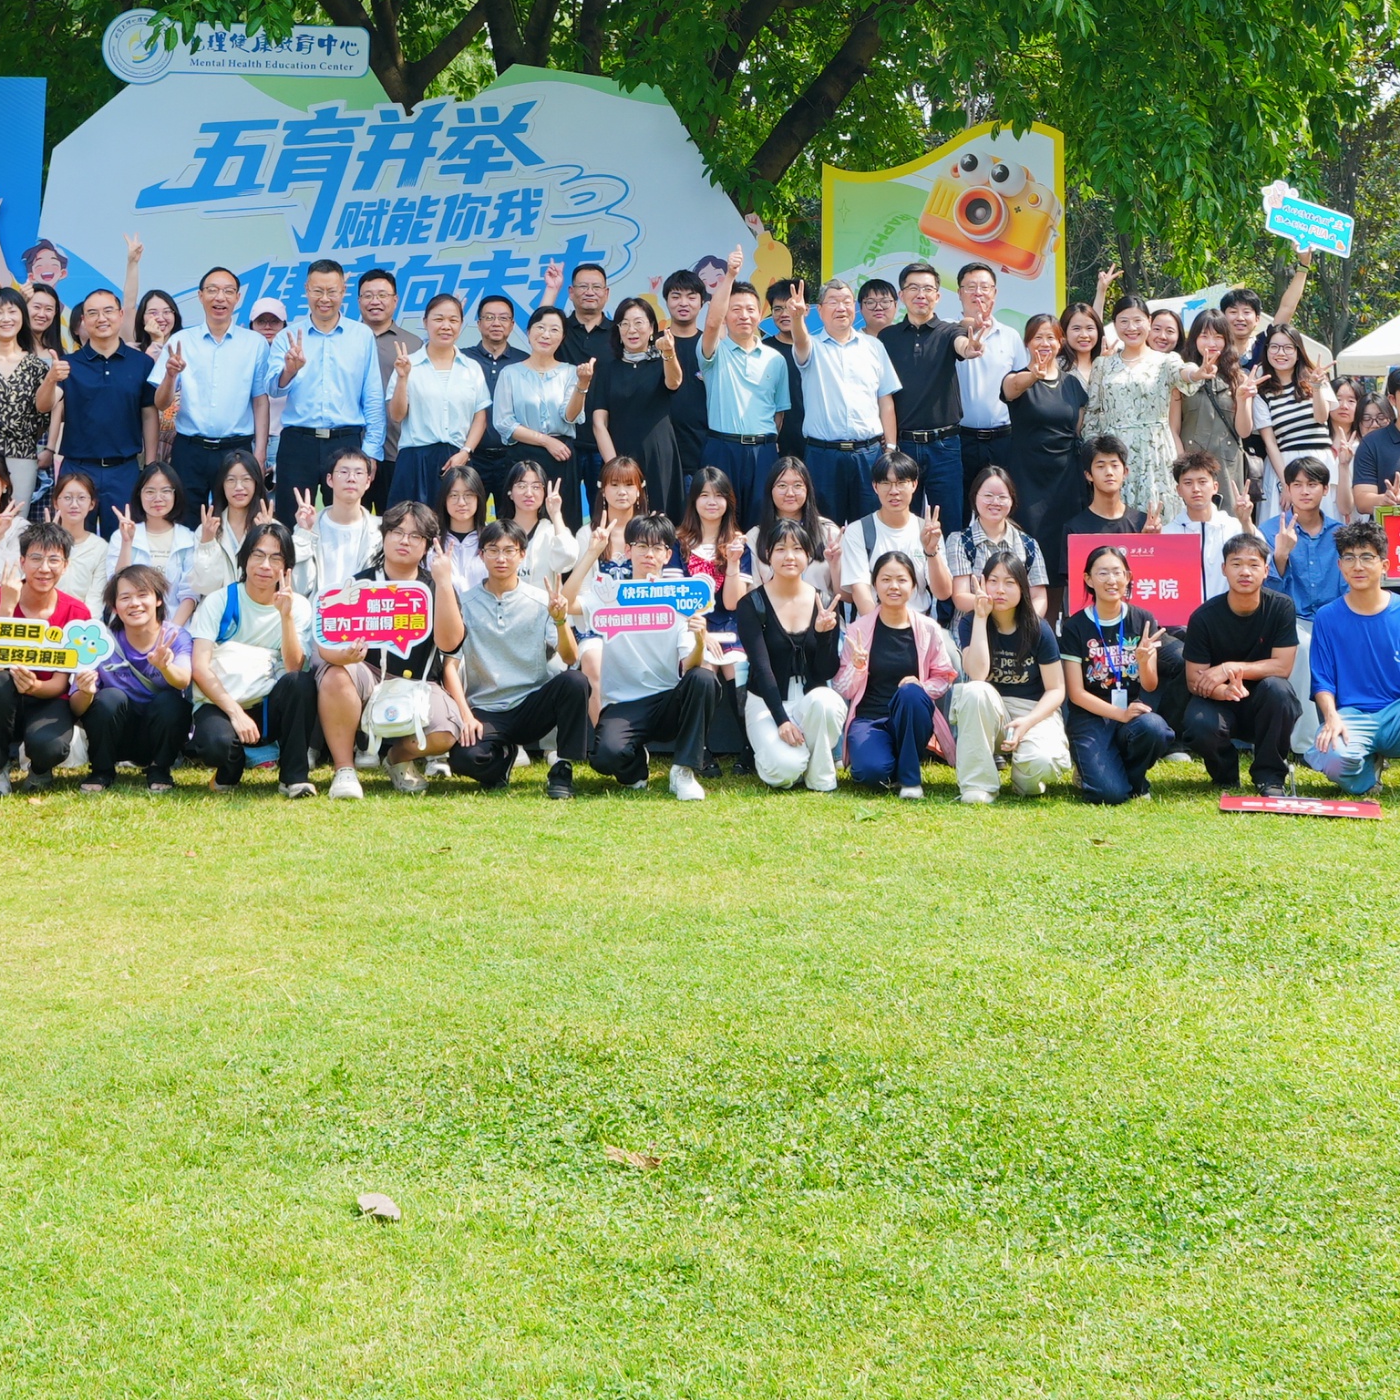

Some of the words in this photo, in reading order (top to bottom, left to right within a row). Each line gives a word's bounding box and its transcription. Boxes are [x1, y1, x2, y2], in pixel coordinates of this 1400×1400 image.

[190, 58, 225, 68] Mental
[228, 59, 262, 69] Health
[265, 60, 317, 70] Education
[320, 61, 354, 71] Center
[135, 100, 546, 253] 五育并举
[331, 188, 544, 251] 赋能你我
[1127, 578, 1180, 600] 学院
[367, 598, 423, 613] 躺平一下
[676, 597, 704, 610] 100%
[0, 623, 40, 639] 爱自己
[323, 613, 426, 632] 是为了蹦得更高
